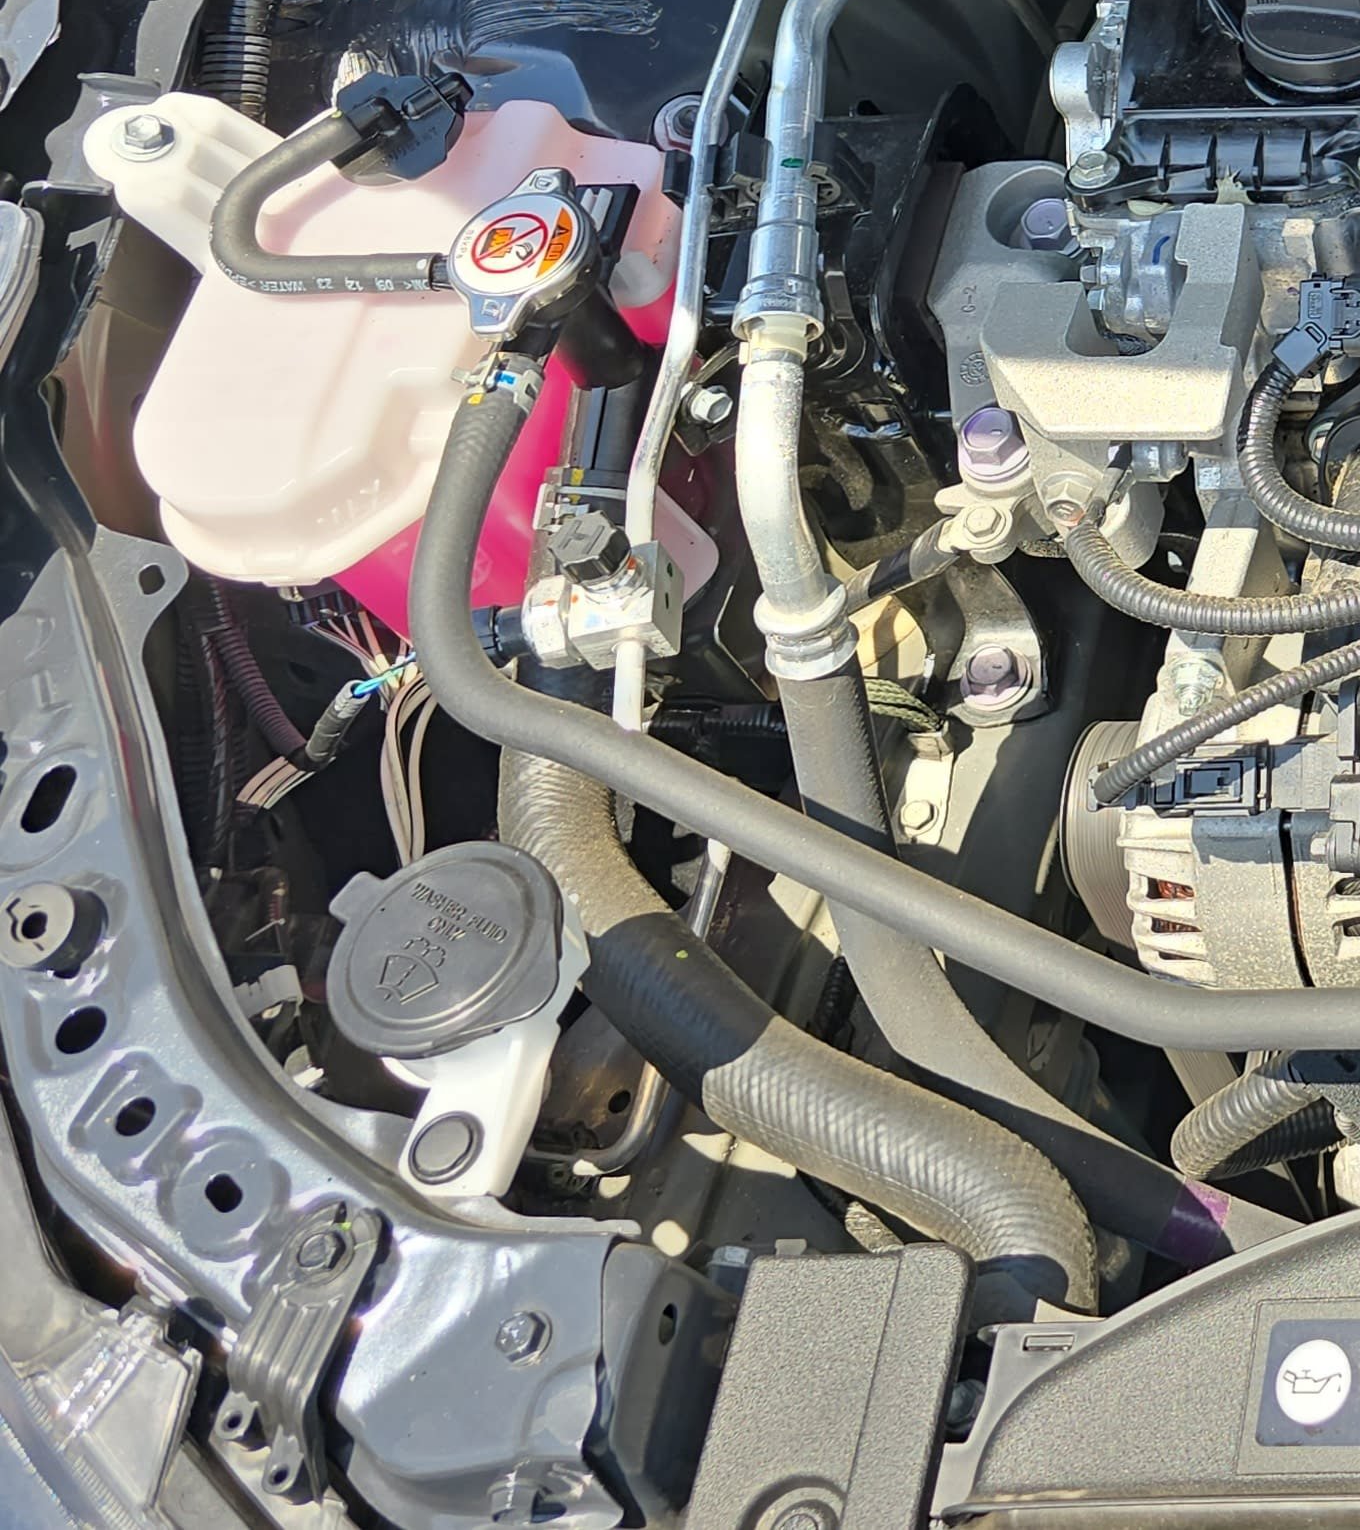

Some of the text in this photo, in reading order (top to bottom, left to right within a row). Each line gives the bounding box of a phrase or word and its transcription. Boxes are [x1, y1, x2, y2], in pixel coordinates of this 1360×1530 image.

[259, 279, 307, 293] WATER
[411, 882, 509, 944] WASHER FLUID
[427, 915, 467, 942] ONLY
